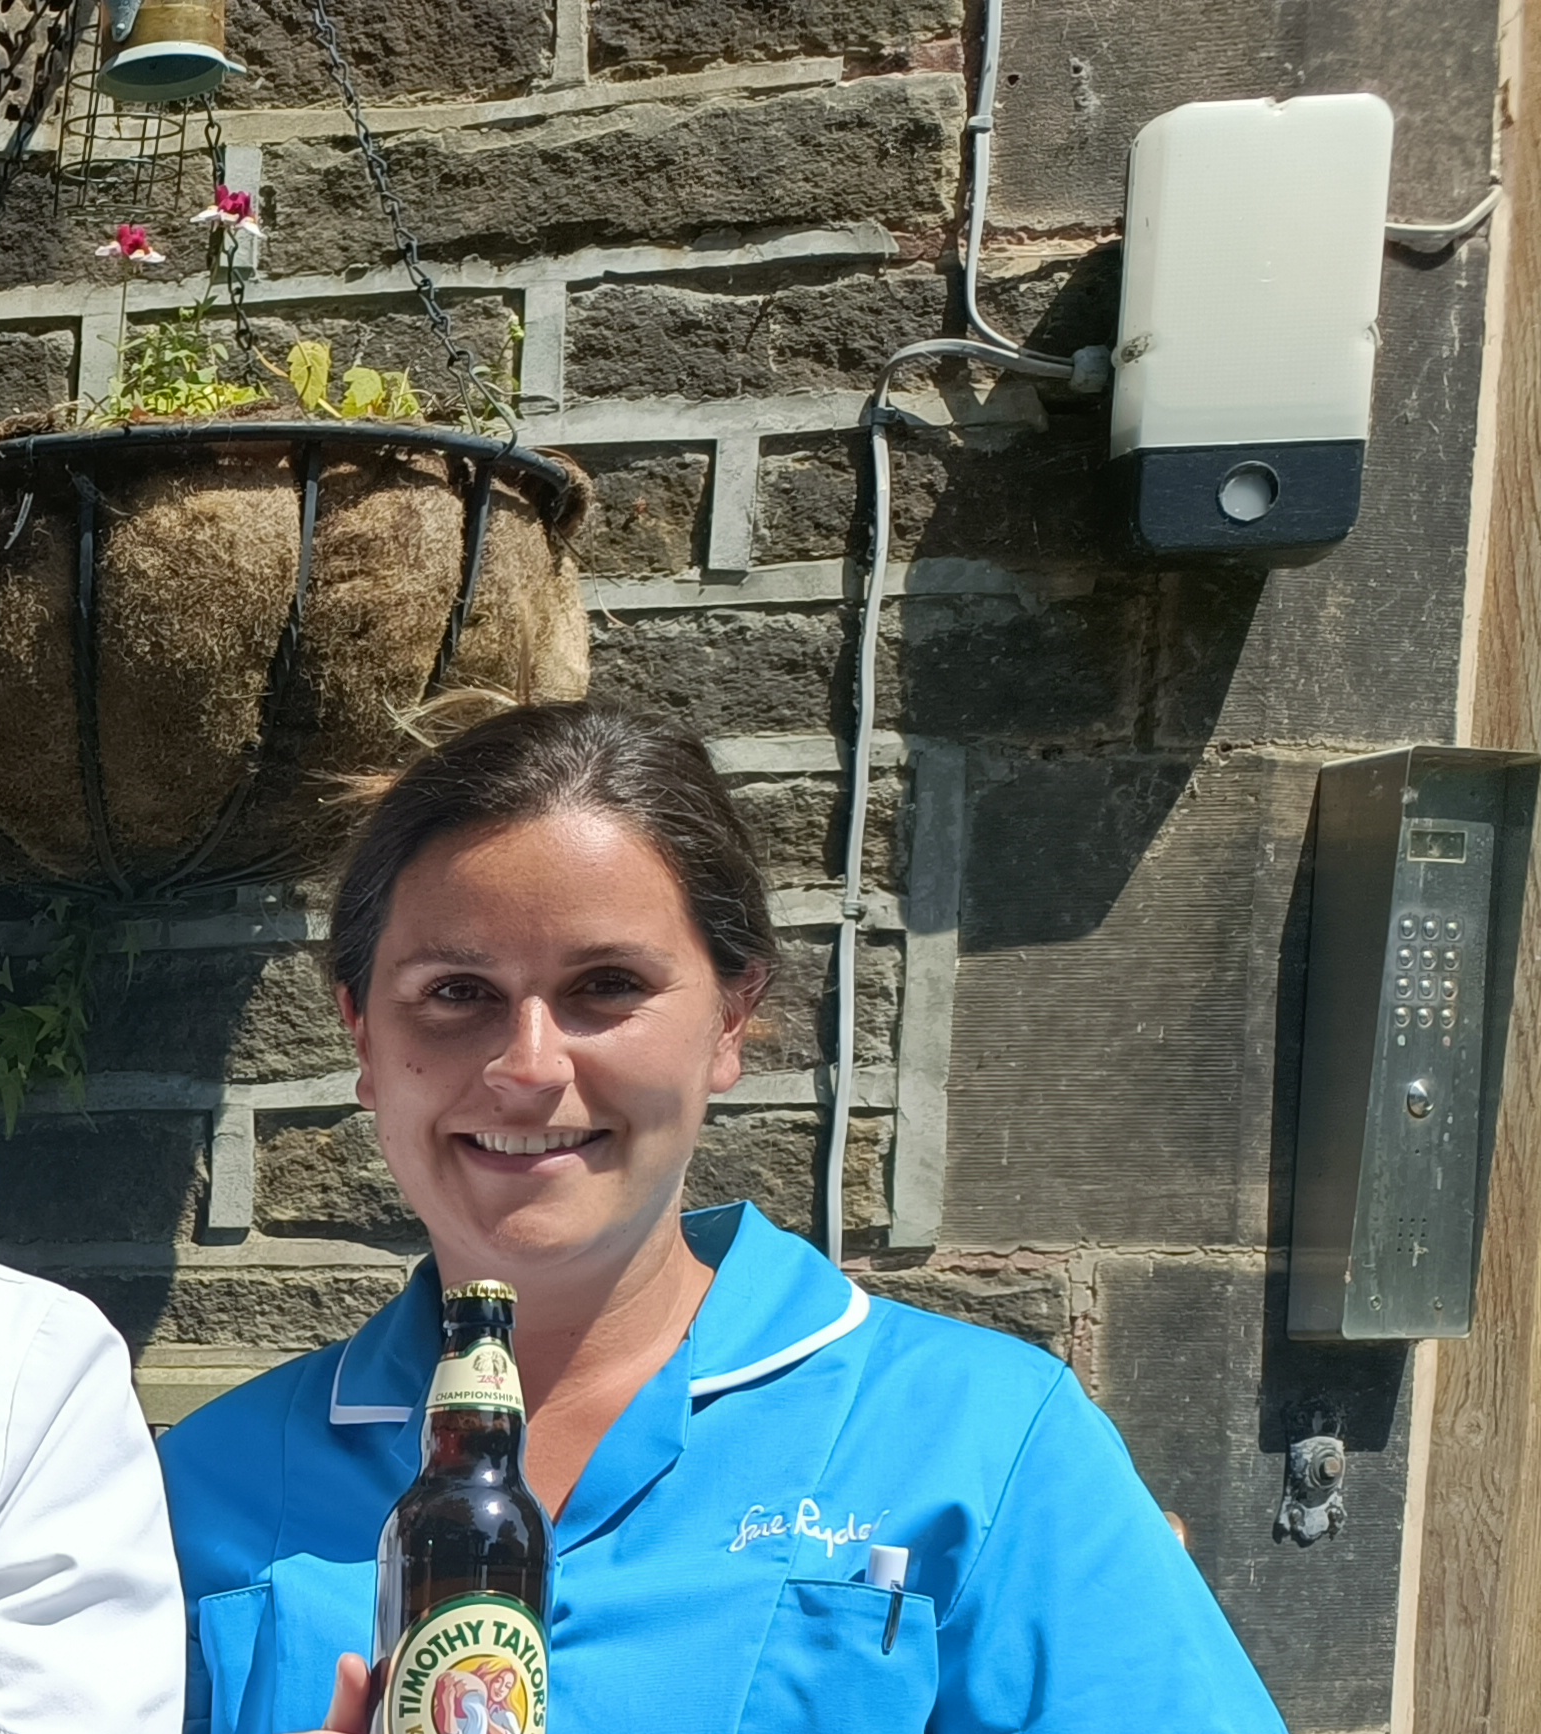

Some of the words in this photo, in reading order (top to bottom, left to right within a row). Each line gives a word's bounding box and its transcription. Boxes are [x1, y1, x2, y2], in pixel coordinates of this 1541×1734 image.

[435, 1390, 513, 1404] CHAMPIONSHIP
[728, 1504, 790, 1552] Sue
[399, 1619, 484, 1719] TIMOTHY
[492, 1620, 546, 1729] TAYLOR'S
